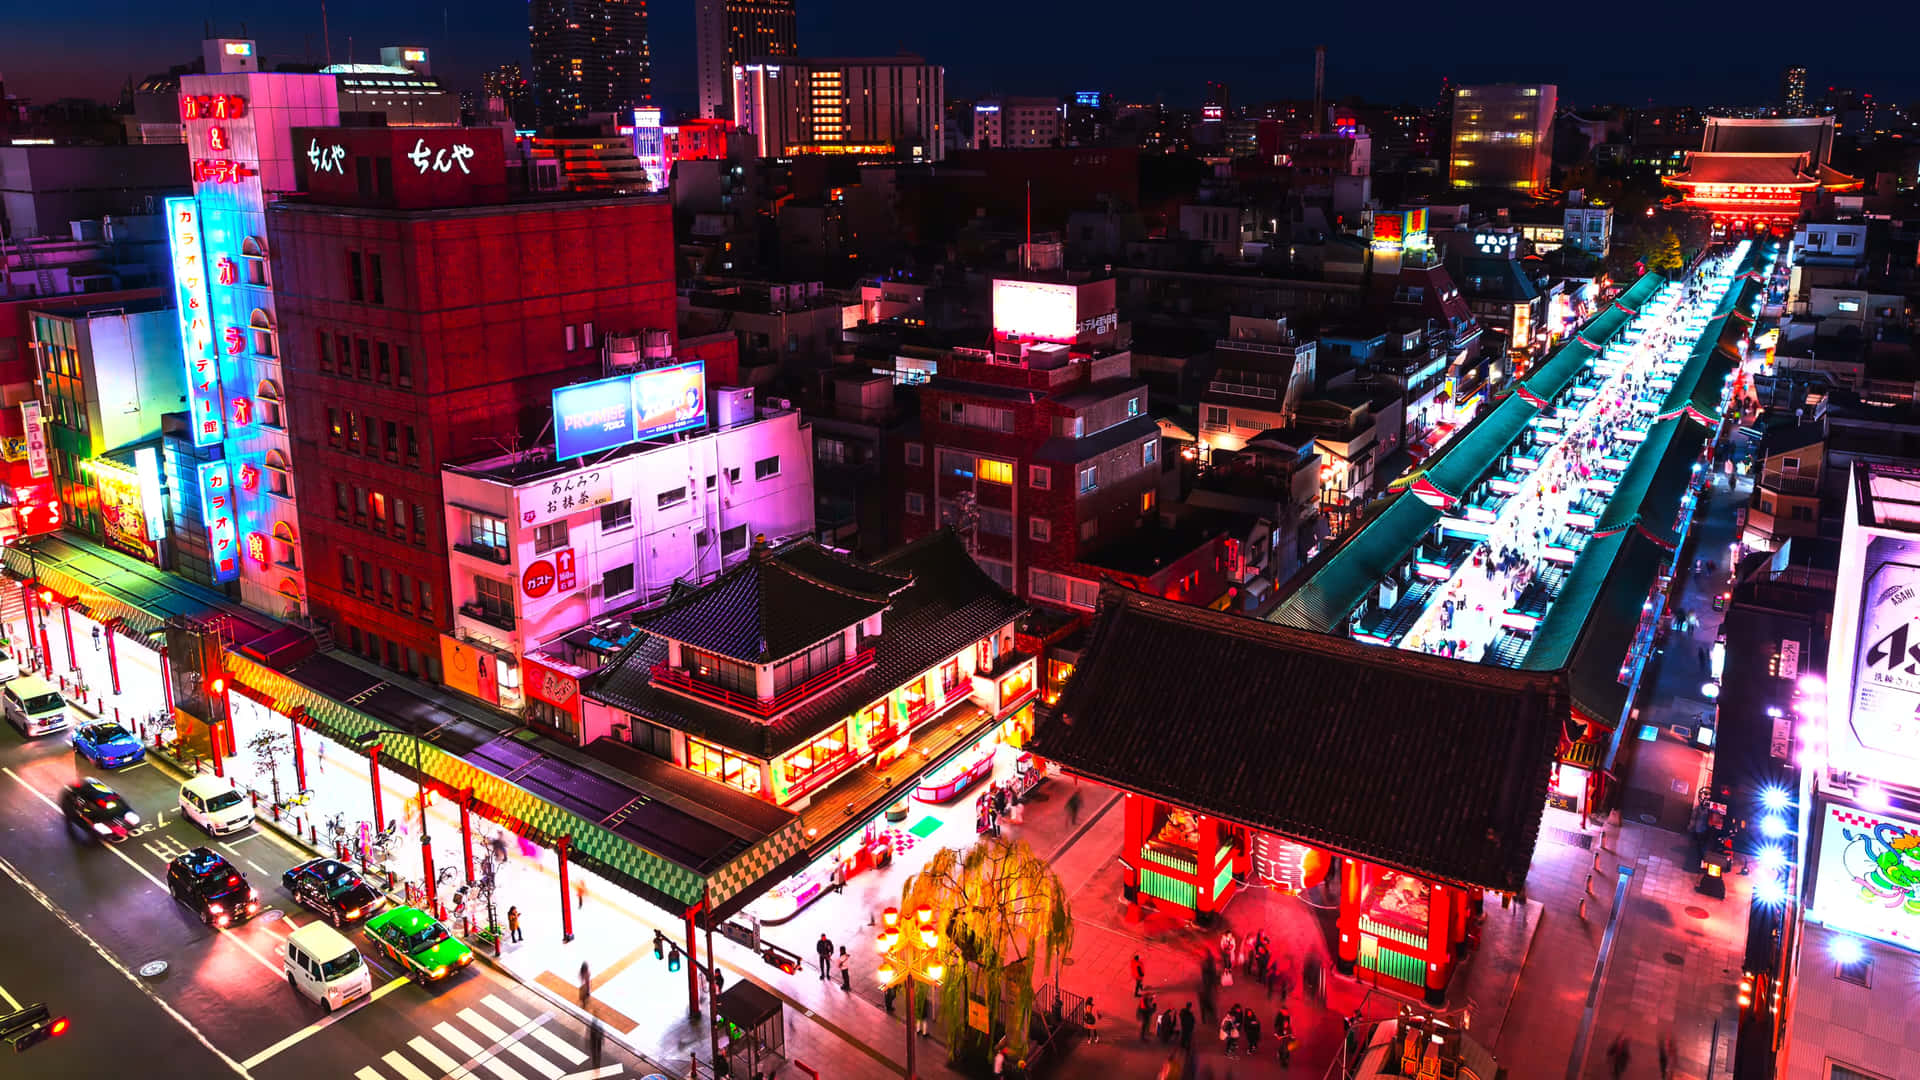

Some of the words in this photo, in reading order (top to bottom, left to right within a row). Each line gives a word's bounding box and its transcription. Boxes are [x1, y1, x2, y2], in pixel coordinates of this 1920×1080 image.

[307, 138, 345, 175] ちんや
[408, 138, 474, 174] ちんや
[564, 404, 626, 431] PROMISE
[551, 472, 600, 496] あんみつ
[546, 490, 590, 513] お抹茶
[210, 475, 235, 571] カラオケ館
[527, 574, 553, 590] ガスト
[1890, 587, 1916, 607] ASAHI
